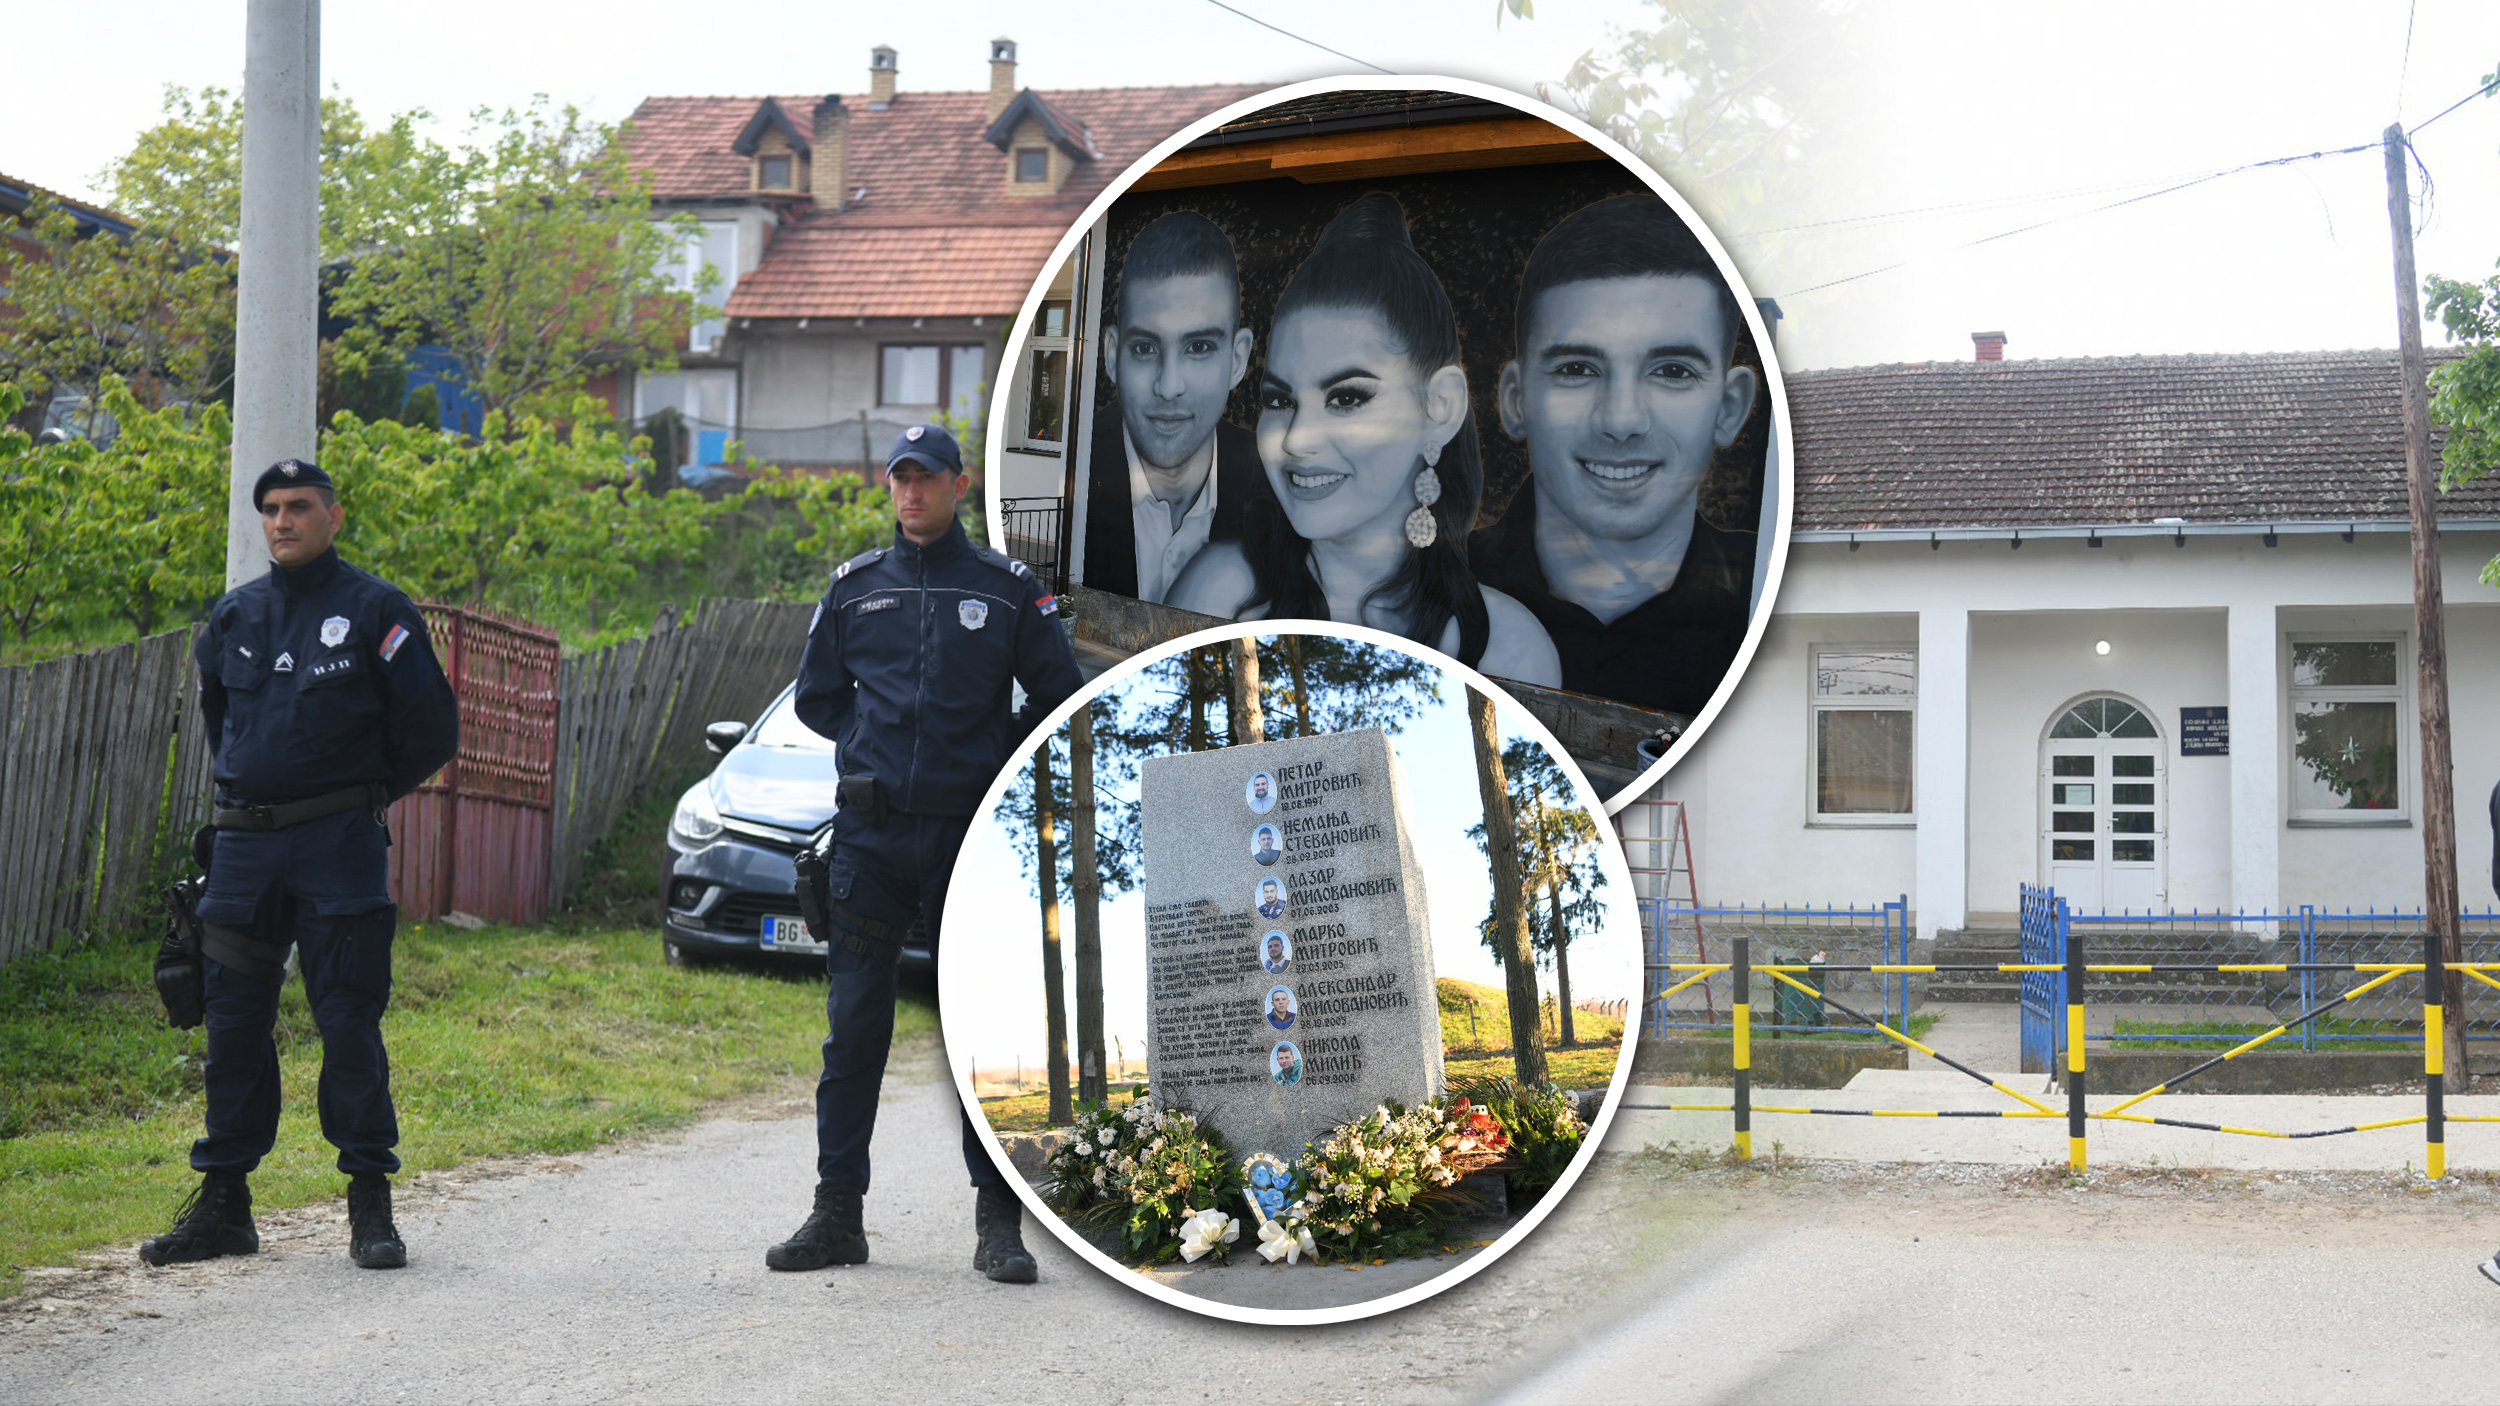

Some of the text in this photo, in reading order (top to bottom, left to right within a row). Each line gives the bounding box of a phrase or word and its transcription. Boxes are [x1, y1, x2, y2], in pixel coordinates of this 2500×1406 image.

[1278, 762, 1322, 782] ПЕТАР
[1280, 773, 1362, 800] МИТРОВИЋ
[1281, 797, 1323, 811] 12.08.1997
[1284, 811, 1350, 835] НЕМАЊА
[1285, 824, 1381, 851] СТЕВАНОВИЋ
[1286, 849, 1335, 864] 28.02.2002
[1289, 868, 1334, 888] ЛАЗАР
[1291, 878, 1396, 906] МИЛОВАНОВИЋ
[1291, 903, 1339, 918] 07.06.2003
[777, 922, 798, 941] BG
[1294, 923, 1345, 943] МАРКО
[1296, 938, 1378, 961] МИТРОВИЋ
[1299, 973, 1396, 998] АЛЕКСАНДАР
[1301, 992, 1408, 1016] МИЛОВАНОВИЋ
[1303, 1036, 1360, 1054] НИКОЛА
[1306, 1055, 1361, 1073] МИЛИЋ
[1306, 1074, 1355, 1086] 06.09.2008
